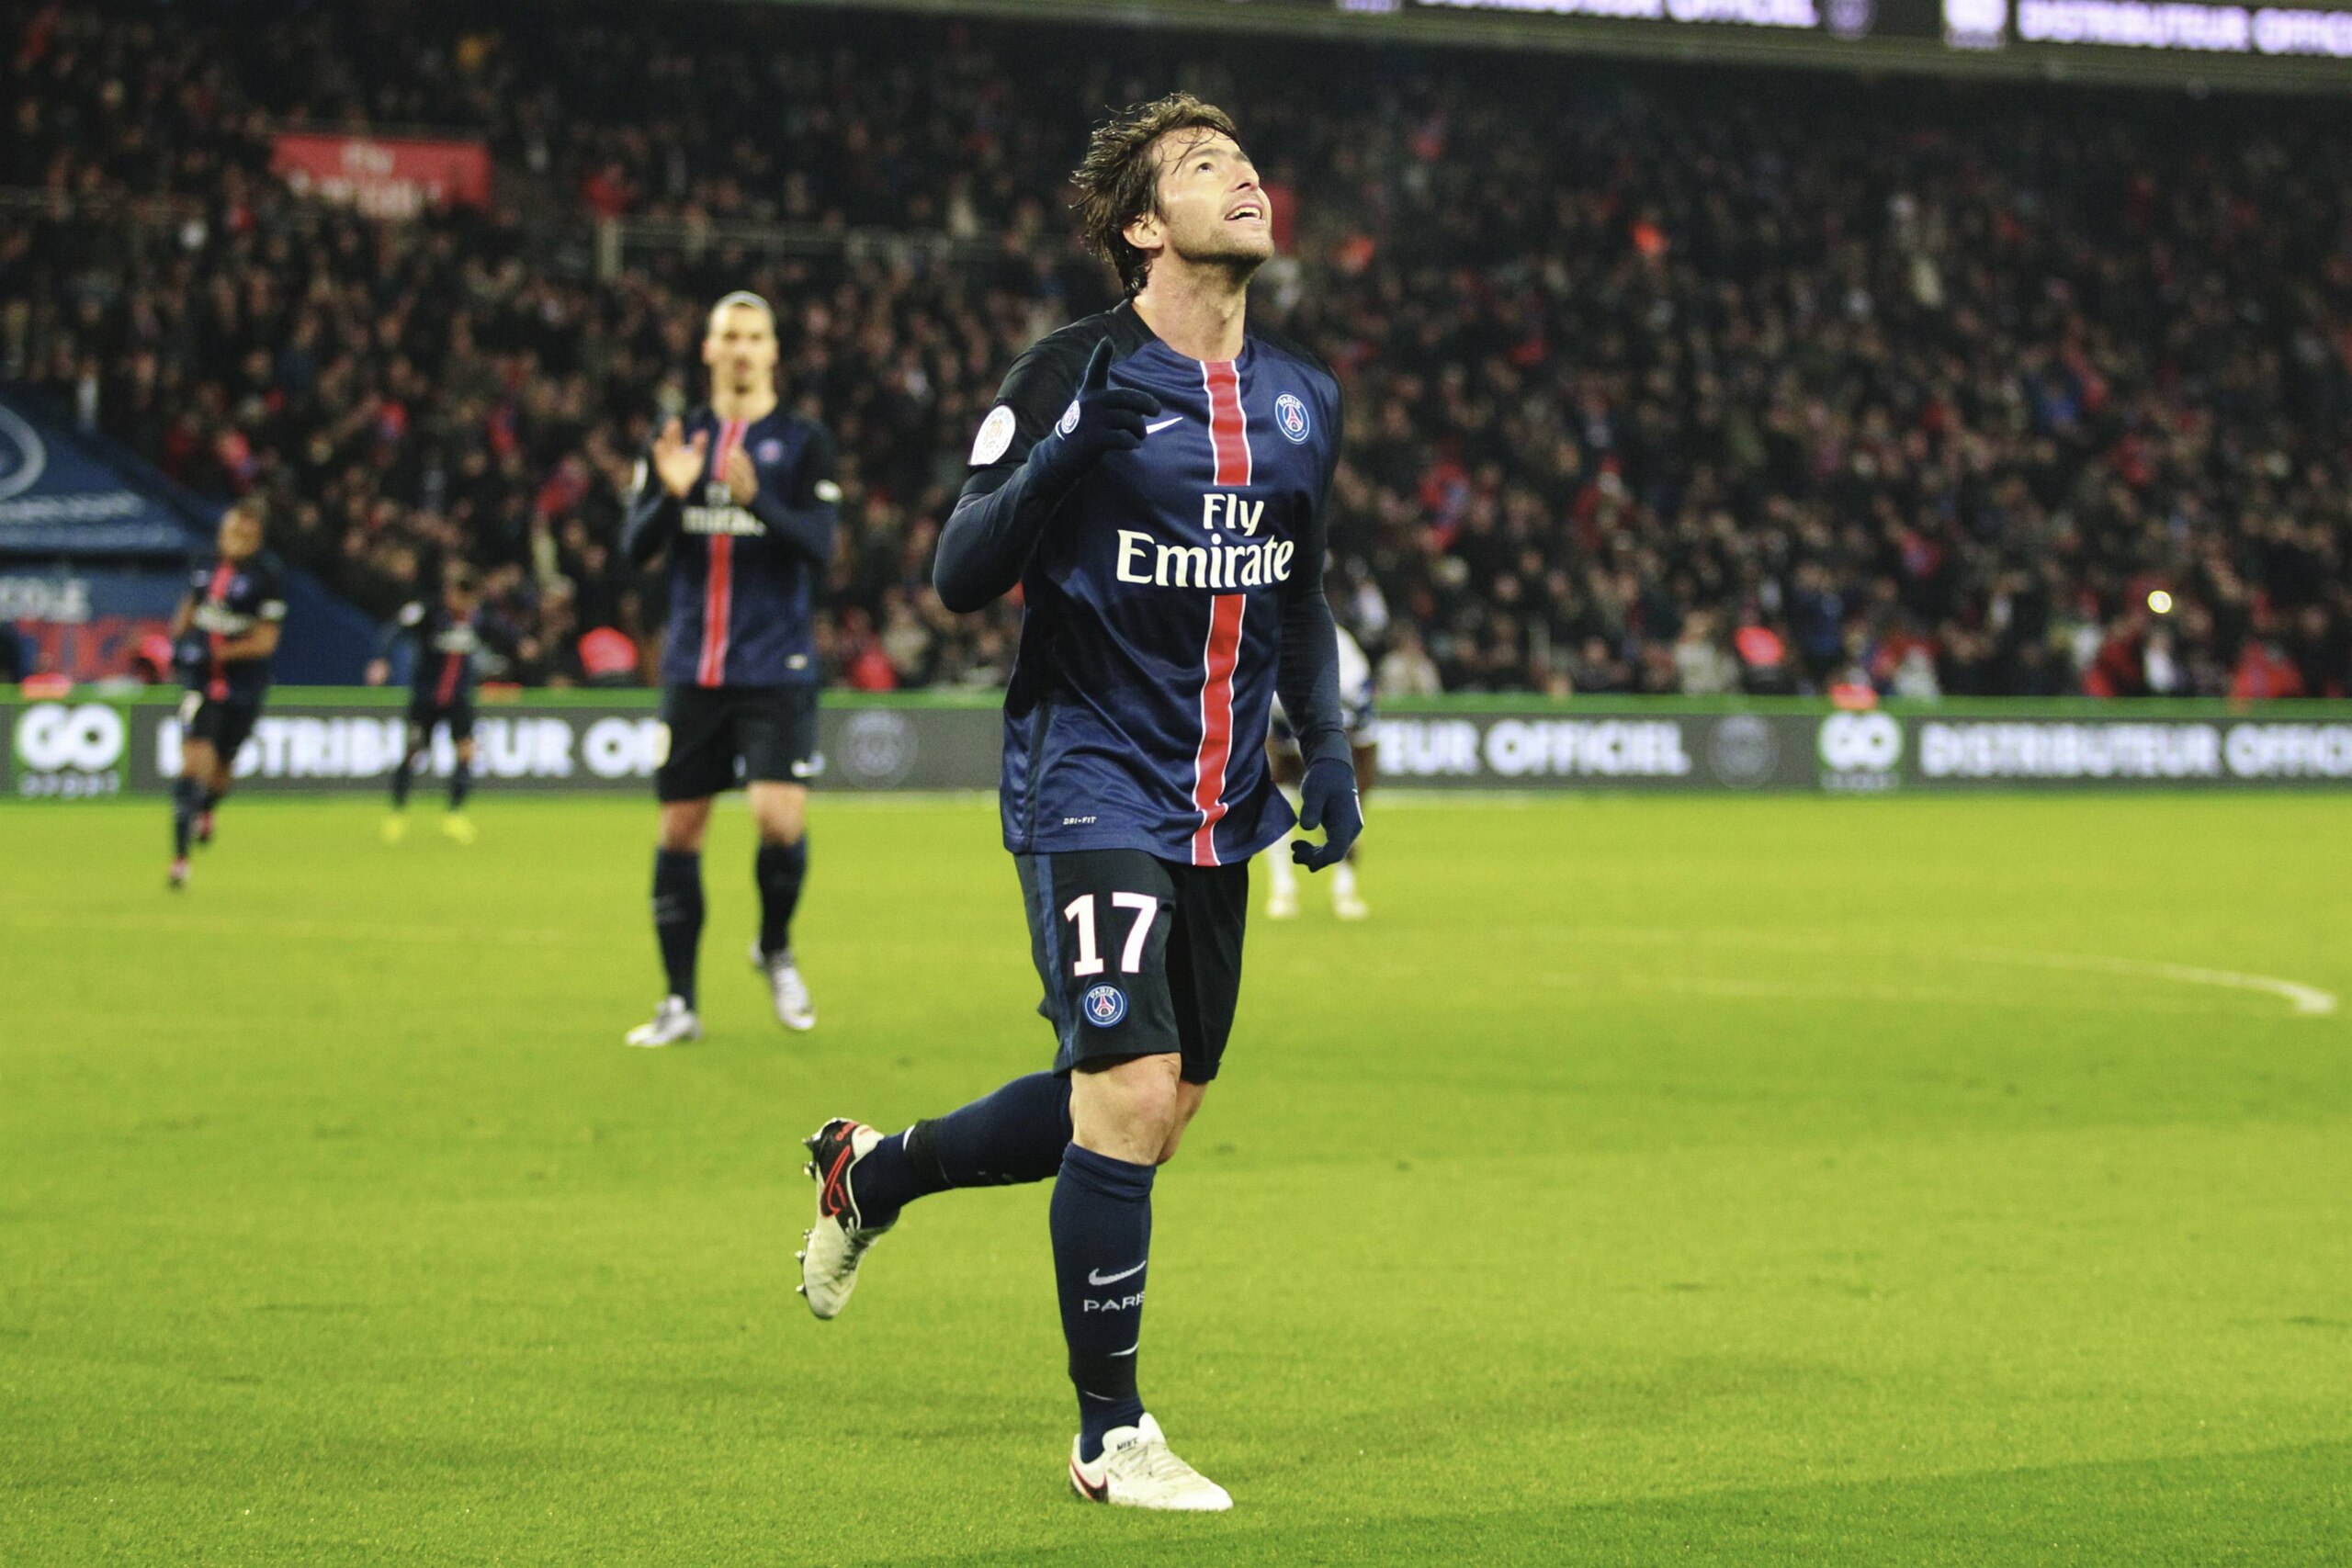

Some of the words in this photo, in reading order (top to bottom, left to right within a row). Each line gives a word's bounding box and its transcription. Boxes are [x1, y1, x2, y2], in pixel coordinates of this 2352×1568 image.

[1203, 493, 1265, 537] Fly
[14, 702, 127, 772] GO
[1486, 718, 1692, 777] OFFICIEL
[1920, 722, 2221, 778] DISTRIBUTEUR
[1063, 891, 1159, 977] 17
